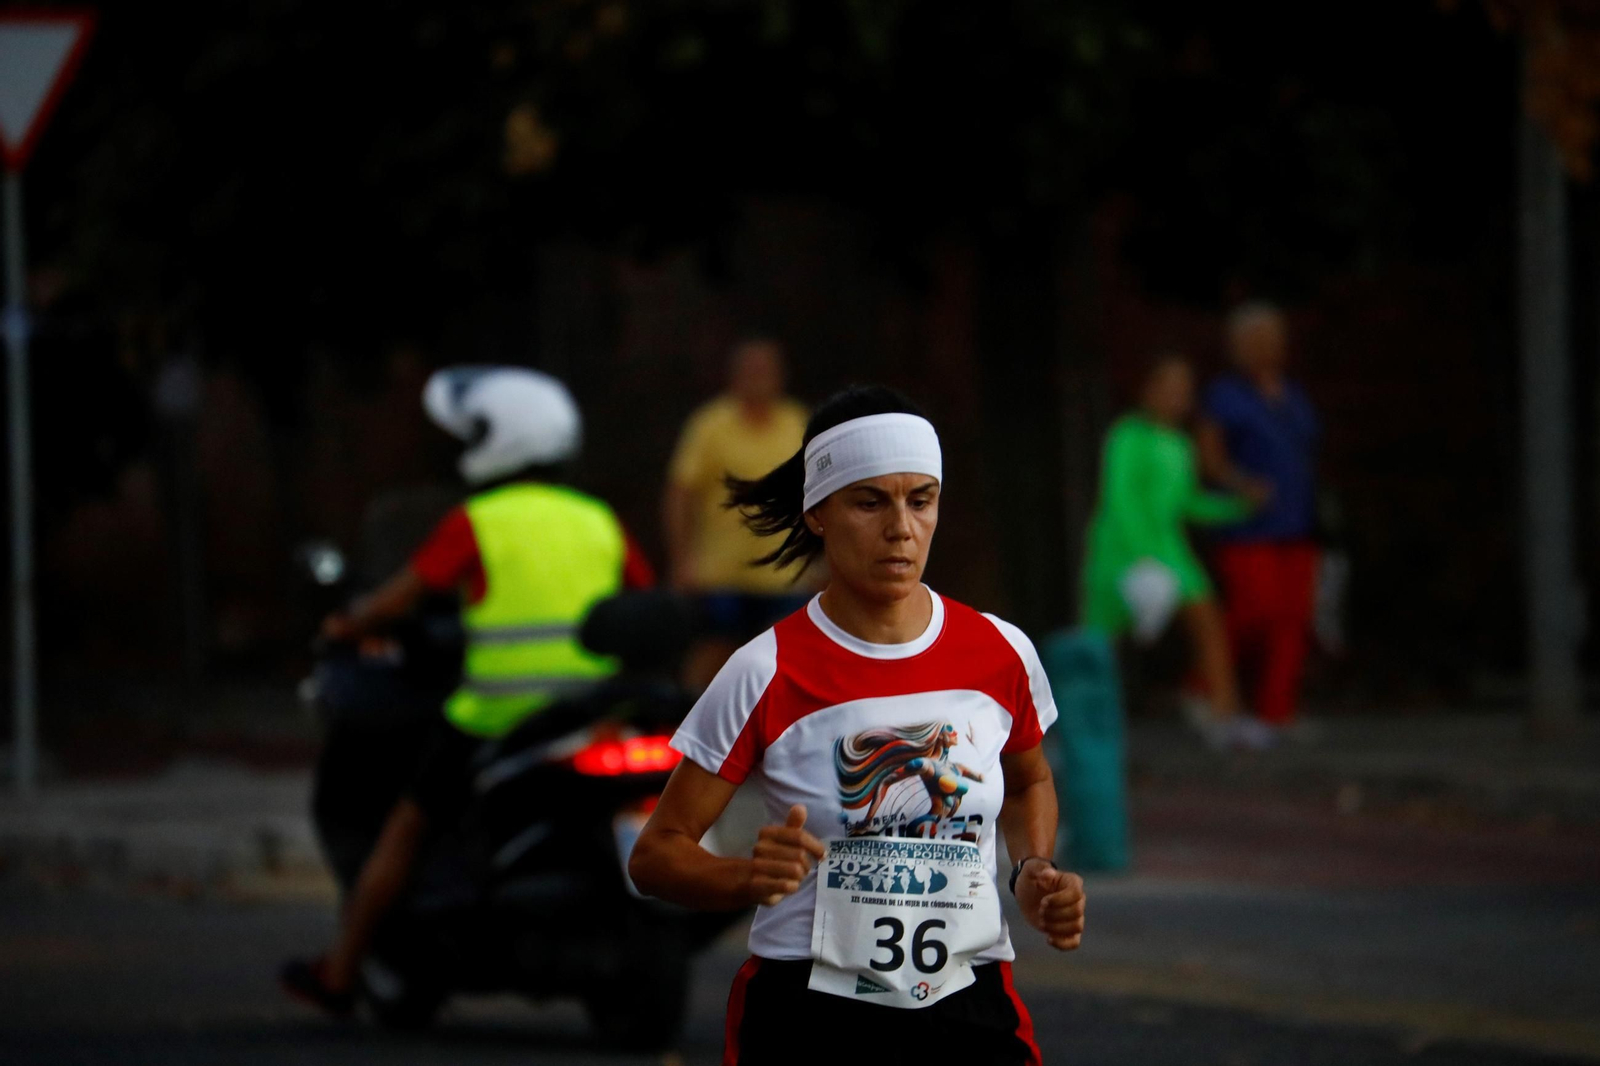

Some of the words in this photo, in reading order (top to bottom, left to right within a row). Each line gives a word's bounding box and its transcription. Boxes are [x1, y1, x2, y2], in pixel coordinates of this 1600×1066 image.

[829, 846, 909, 858] CARRERAS
[898, 843, 976, 853] PROVINCIAL
[828, 859, 898, 877] 2024
[861, 896, 887, 906] CARRERA
[897, 899, 903, 907] LA
[904, 900, 920, 909] MUJER
[921, 900, 929, 908] DE
[958, 902, 974, 910] 2024
[869, 916, 948, 974] 36
